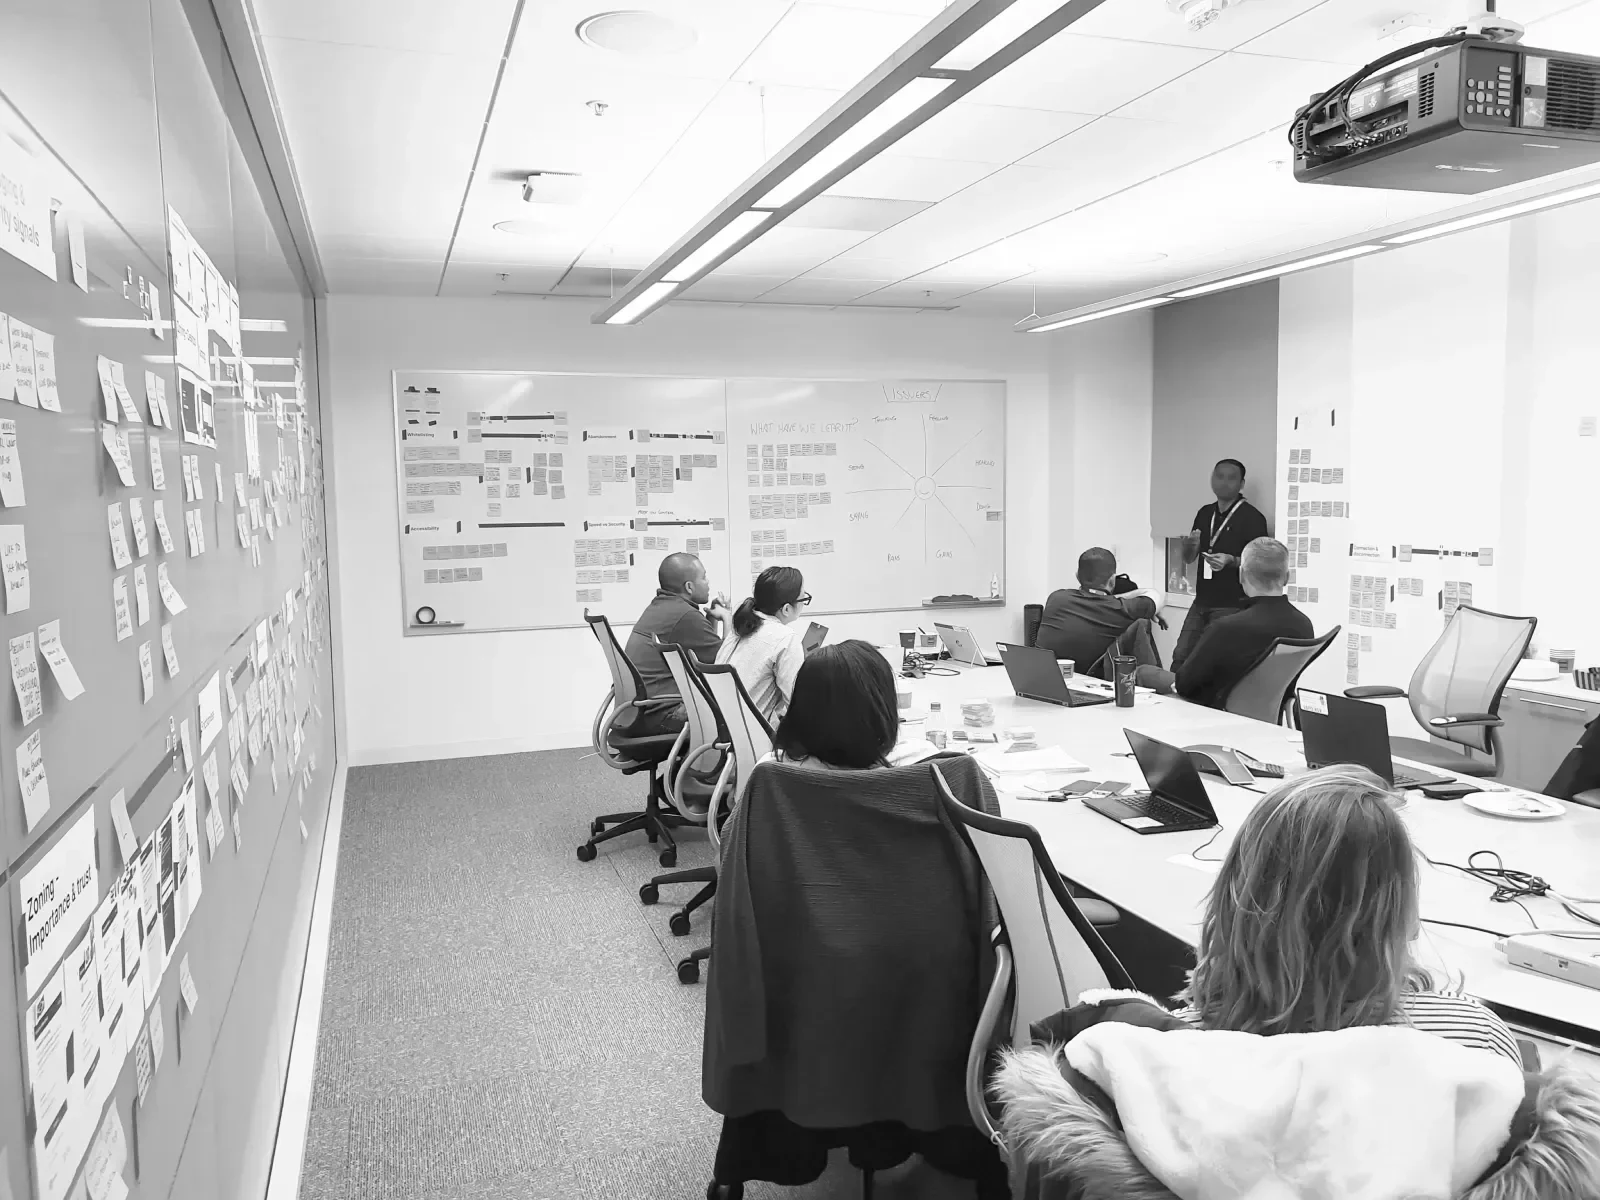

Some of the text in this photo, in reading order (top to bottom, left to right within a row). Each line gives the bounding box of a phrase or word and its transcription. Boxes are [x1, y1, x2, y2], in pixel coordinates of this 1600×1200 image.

[13, 212, 40, 247] signals
[892, 387, 932, 400] ISSUERS
[750, 422, 774, 435] WHAT
[778, 422, 797, 434] HAVE
[799, 422, 816, 433] WE
[27, 880, 55, 922] Zoning
[29, 864, 92, 956] Importance & trust
